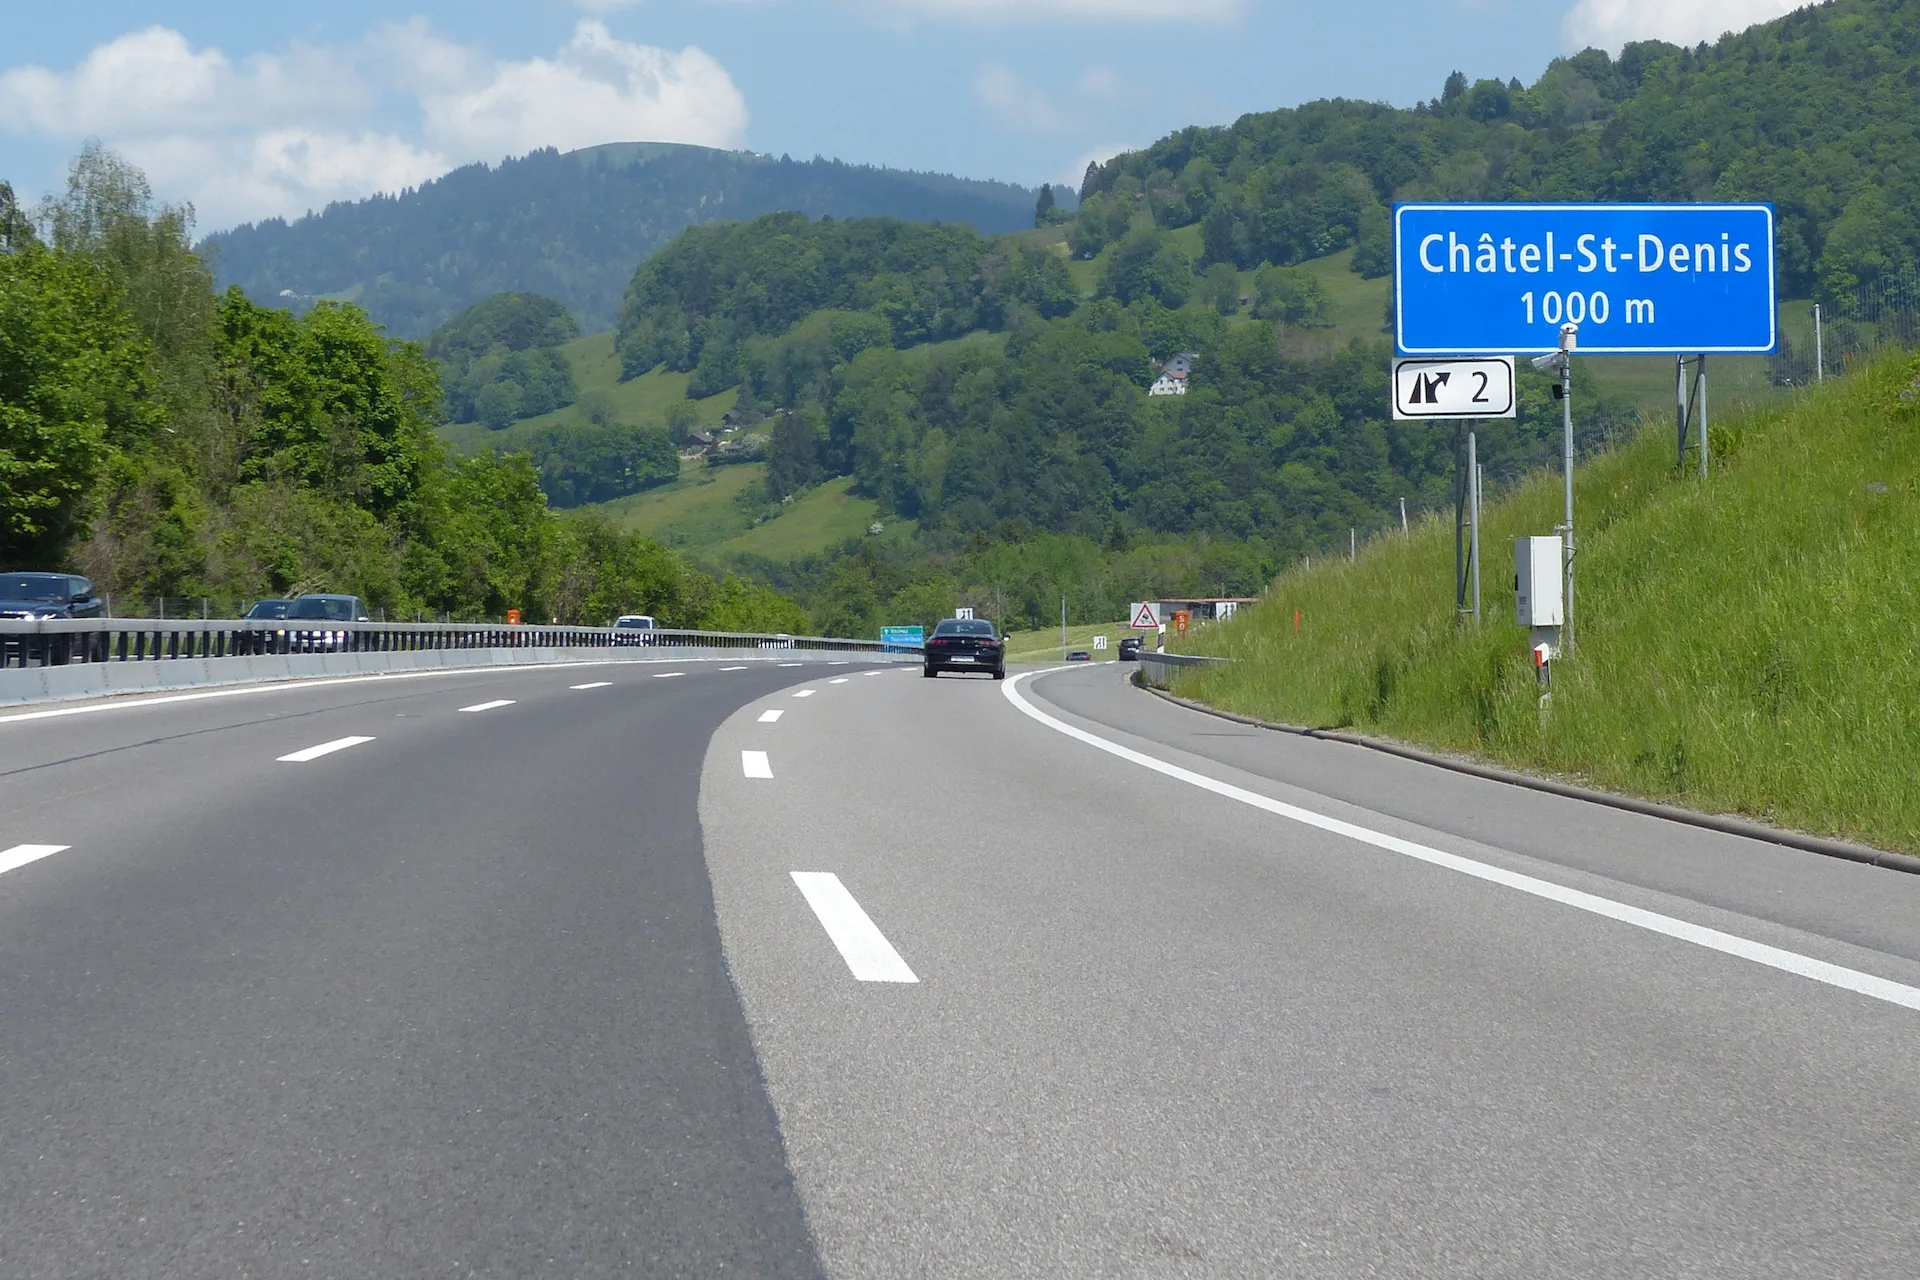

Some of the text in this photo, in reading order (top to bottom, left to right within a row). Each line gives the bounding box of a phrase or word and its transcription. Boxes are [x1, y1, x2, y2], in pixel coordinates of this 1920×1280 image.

[1419, 231, 1752, 273] Châtel-St-Denis
[1521, 291, 1655, 324] 1000 m
[1471, 371, 1489, 402] 2
